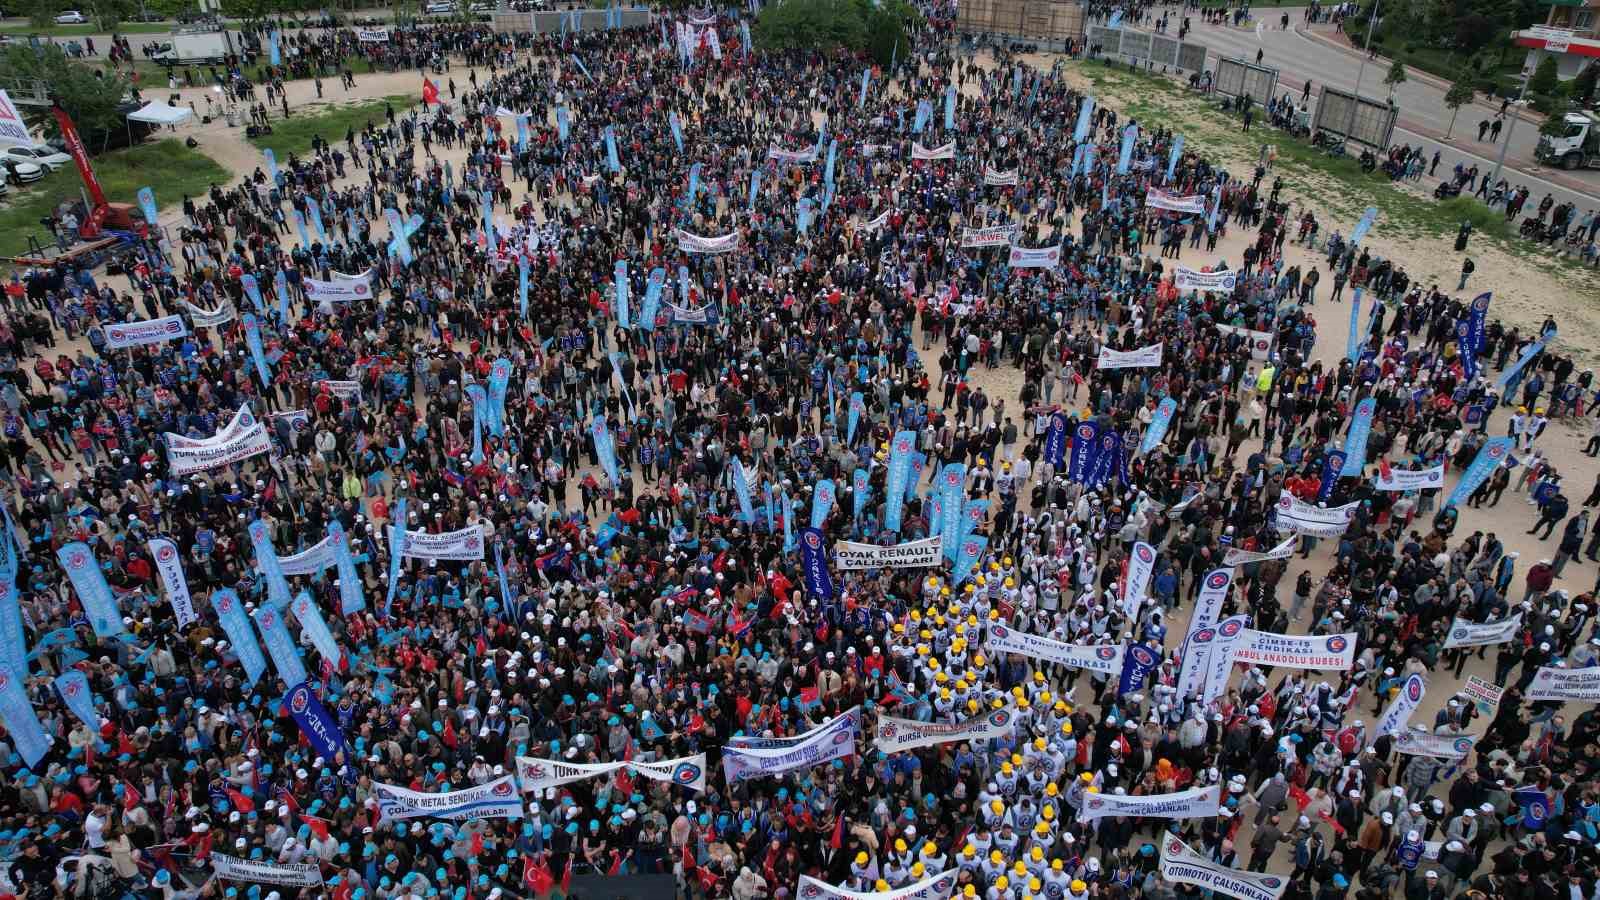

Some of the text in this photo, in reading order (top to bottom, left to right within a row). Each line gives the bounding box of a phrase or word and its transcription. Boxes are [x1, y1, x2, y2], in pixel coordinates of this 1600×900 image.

[839, 546, 940, 559] OYAK RENAULT
[1263, 653, 1307, 665] ANADOLU
[553, 763, 580, 779] TÜRK
[420, 797, 447, 808] METAL
[1168, 866, 1212, 882] OTOMOTİV
